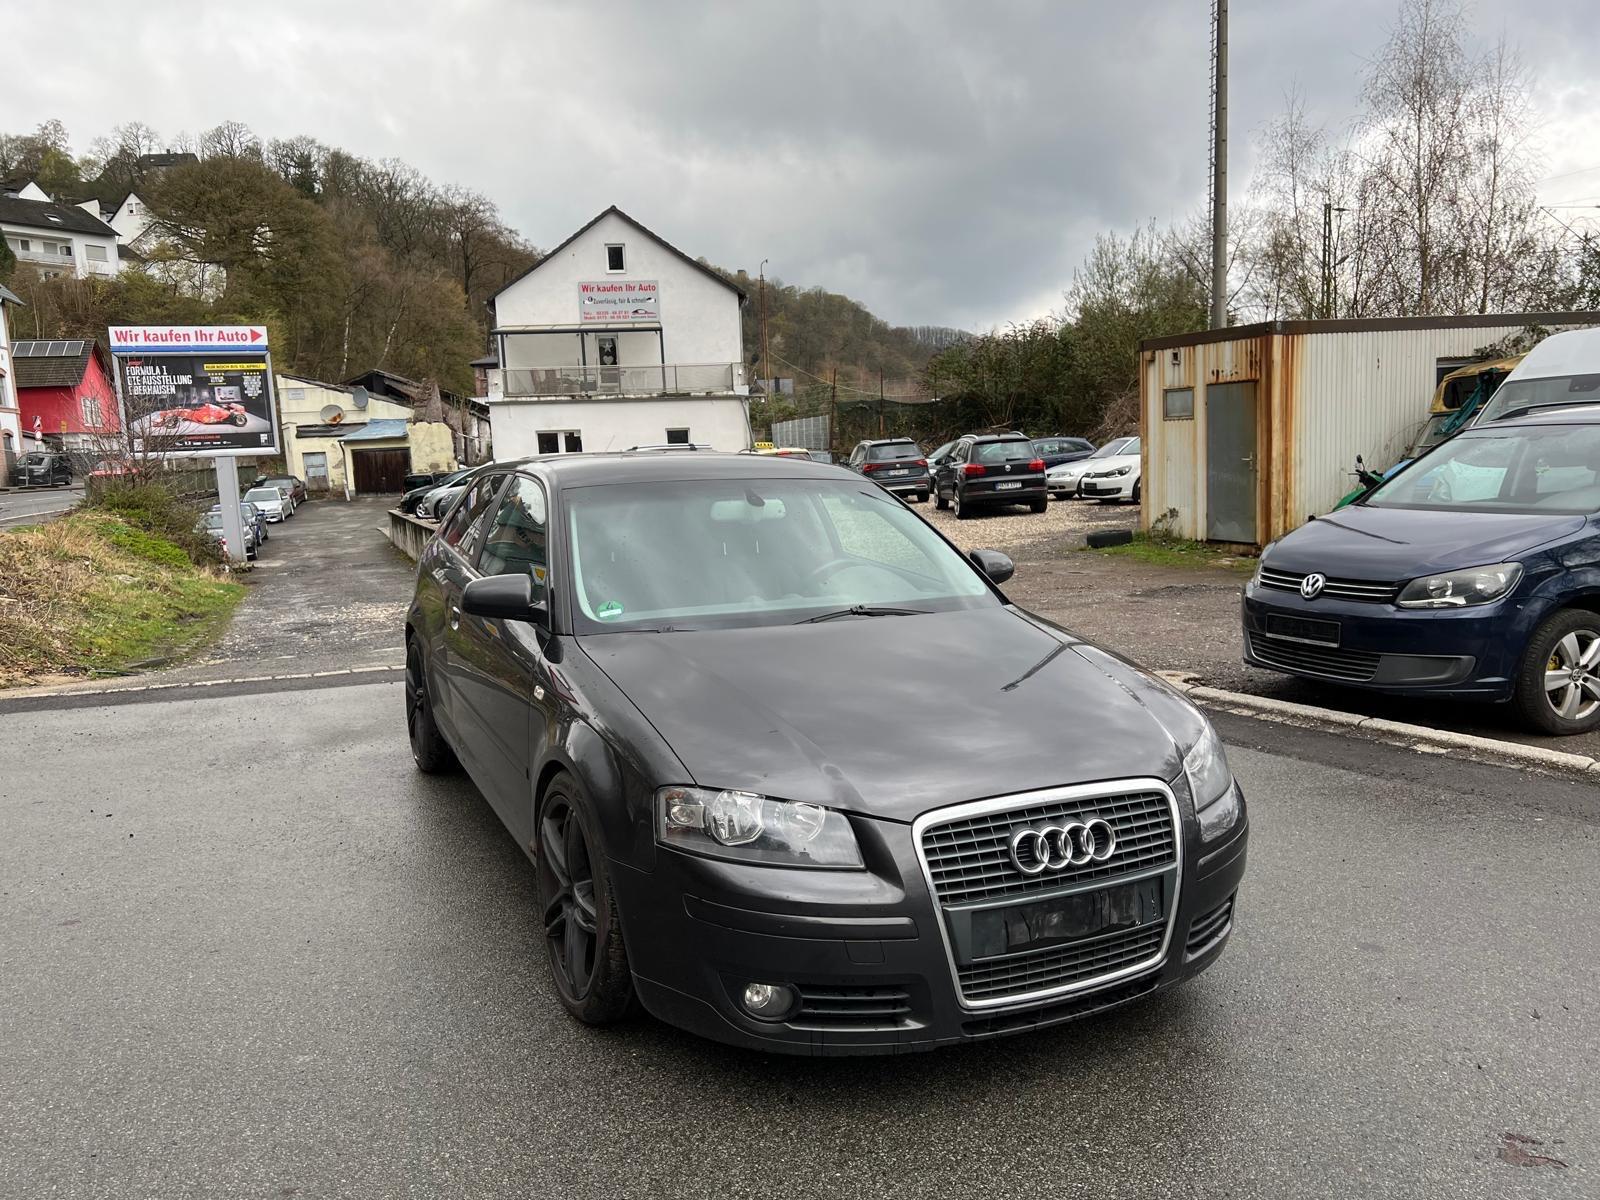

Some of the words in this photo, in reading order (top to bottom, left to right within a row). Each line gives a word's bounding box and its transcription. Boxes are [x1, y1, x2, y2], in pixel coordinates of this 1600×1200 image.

[581, 285, 594, 293] Wir
[597, 284, 623, 292] kaufen
[625, 283, 636, 292] Ihr
[638, 283, 657, 292] Auto
[114, 330, 140, 342] Wir
[144, 330, 193, 342] kaufen
[195, 330, 214, 342] Ihr
[217, 329, 248, 342] Auto
[126, 366, 161, 376] FORMULA
[162, 365, 168, 375] 1
[142, 375, 193, 386] AUSSTELLUNG
